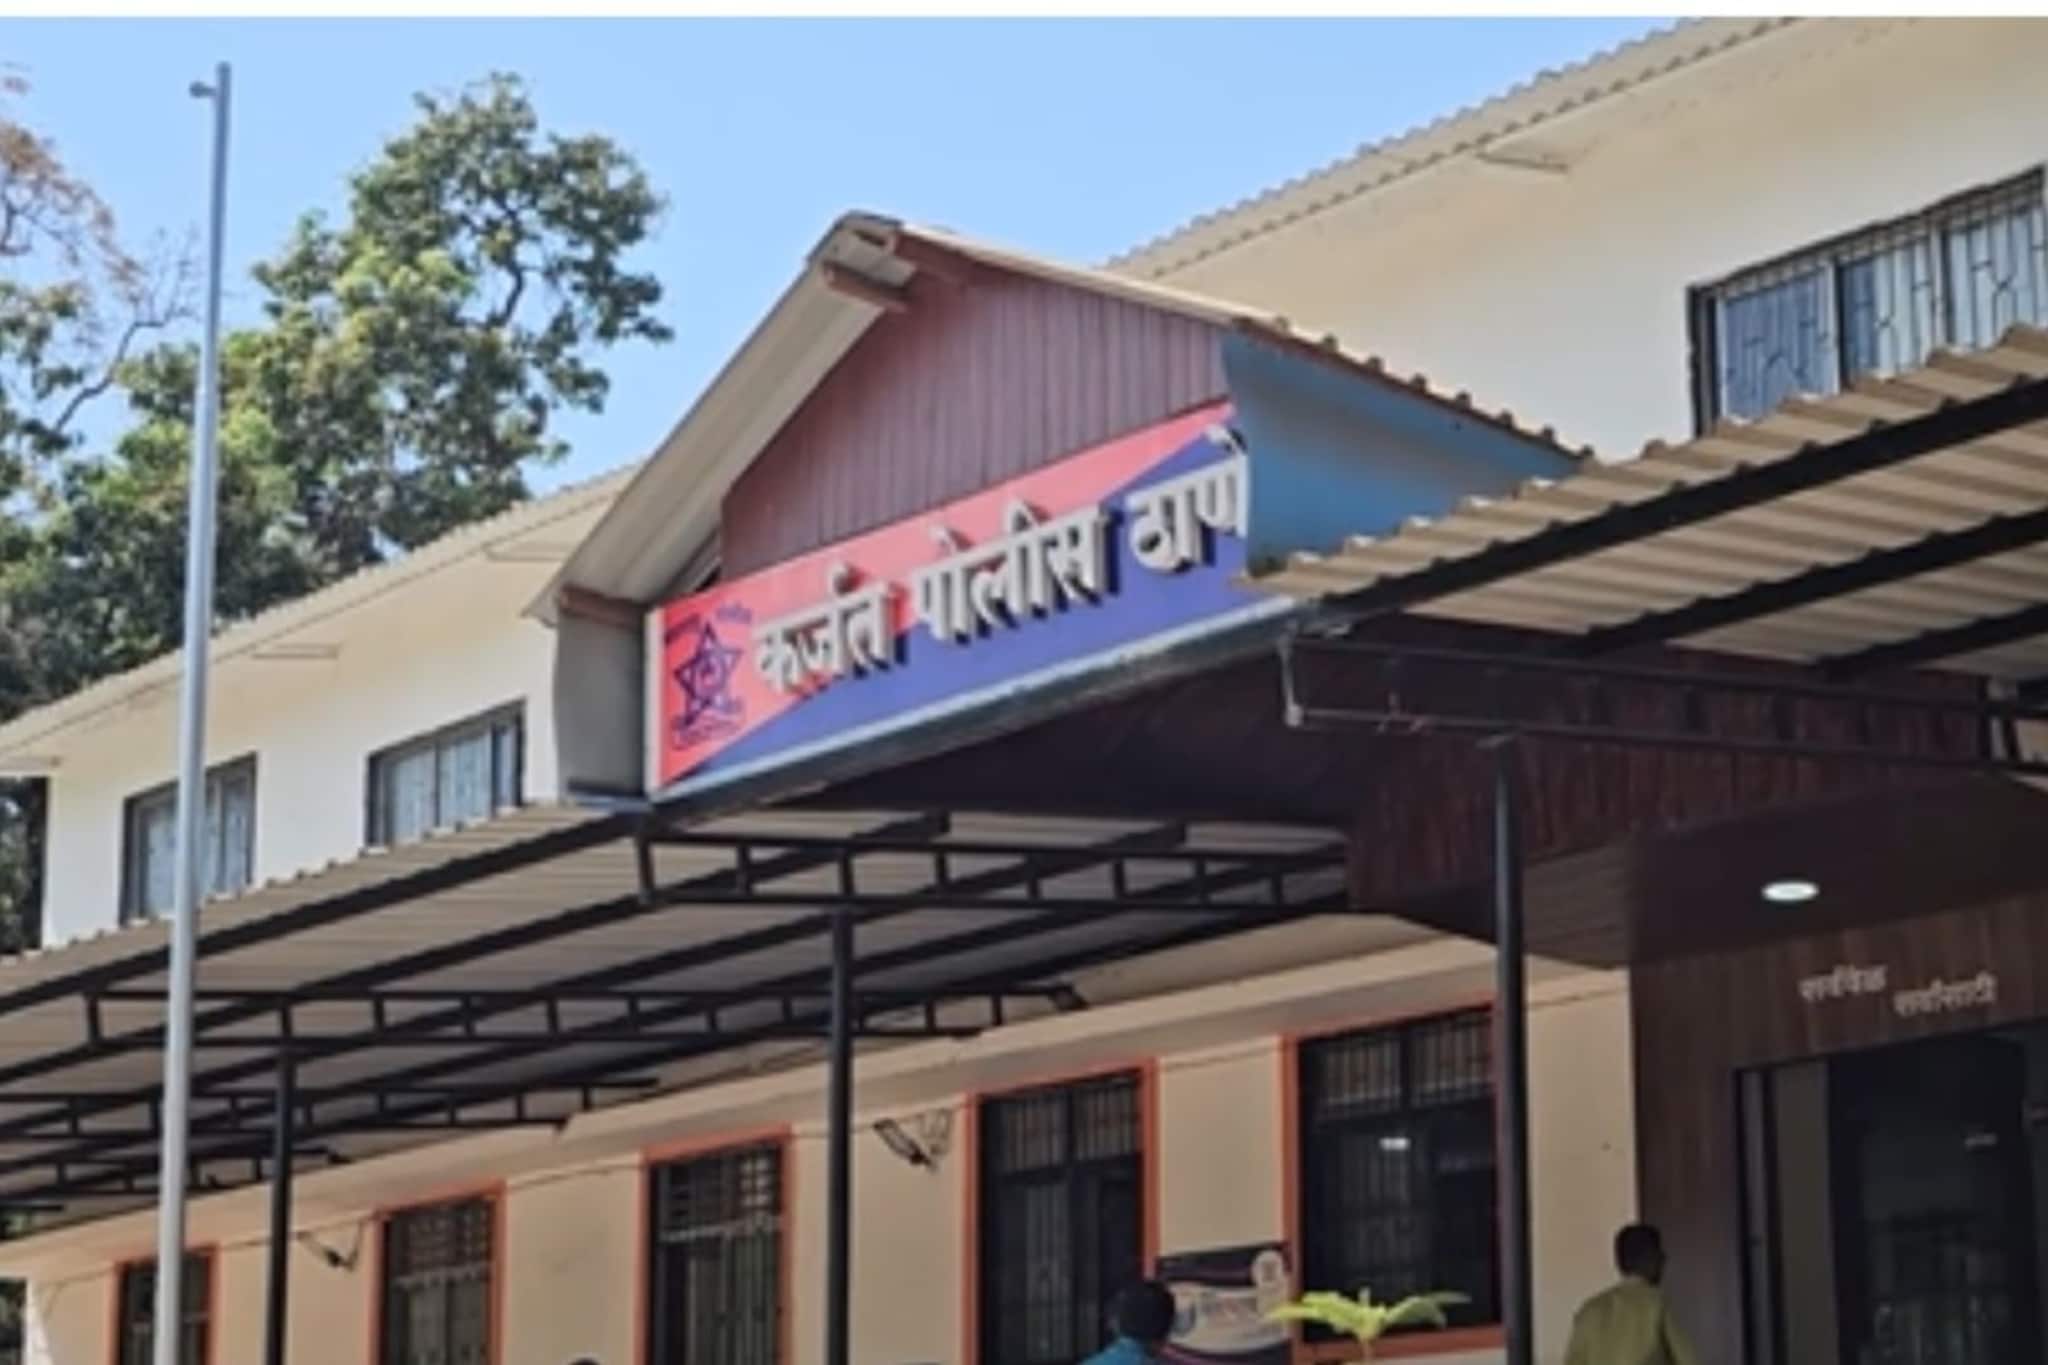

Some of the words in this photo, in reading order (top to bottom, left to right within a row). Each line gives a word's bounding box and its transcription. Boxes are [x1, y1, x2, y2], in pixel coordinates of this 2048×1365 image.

[755, 561, 893, 693] कर्जत
[913, 498, 1106, 641] पोलीस
[1126, 424, 1250, 571] ठाणे
